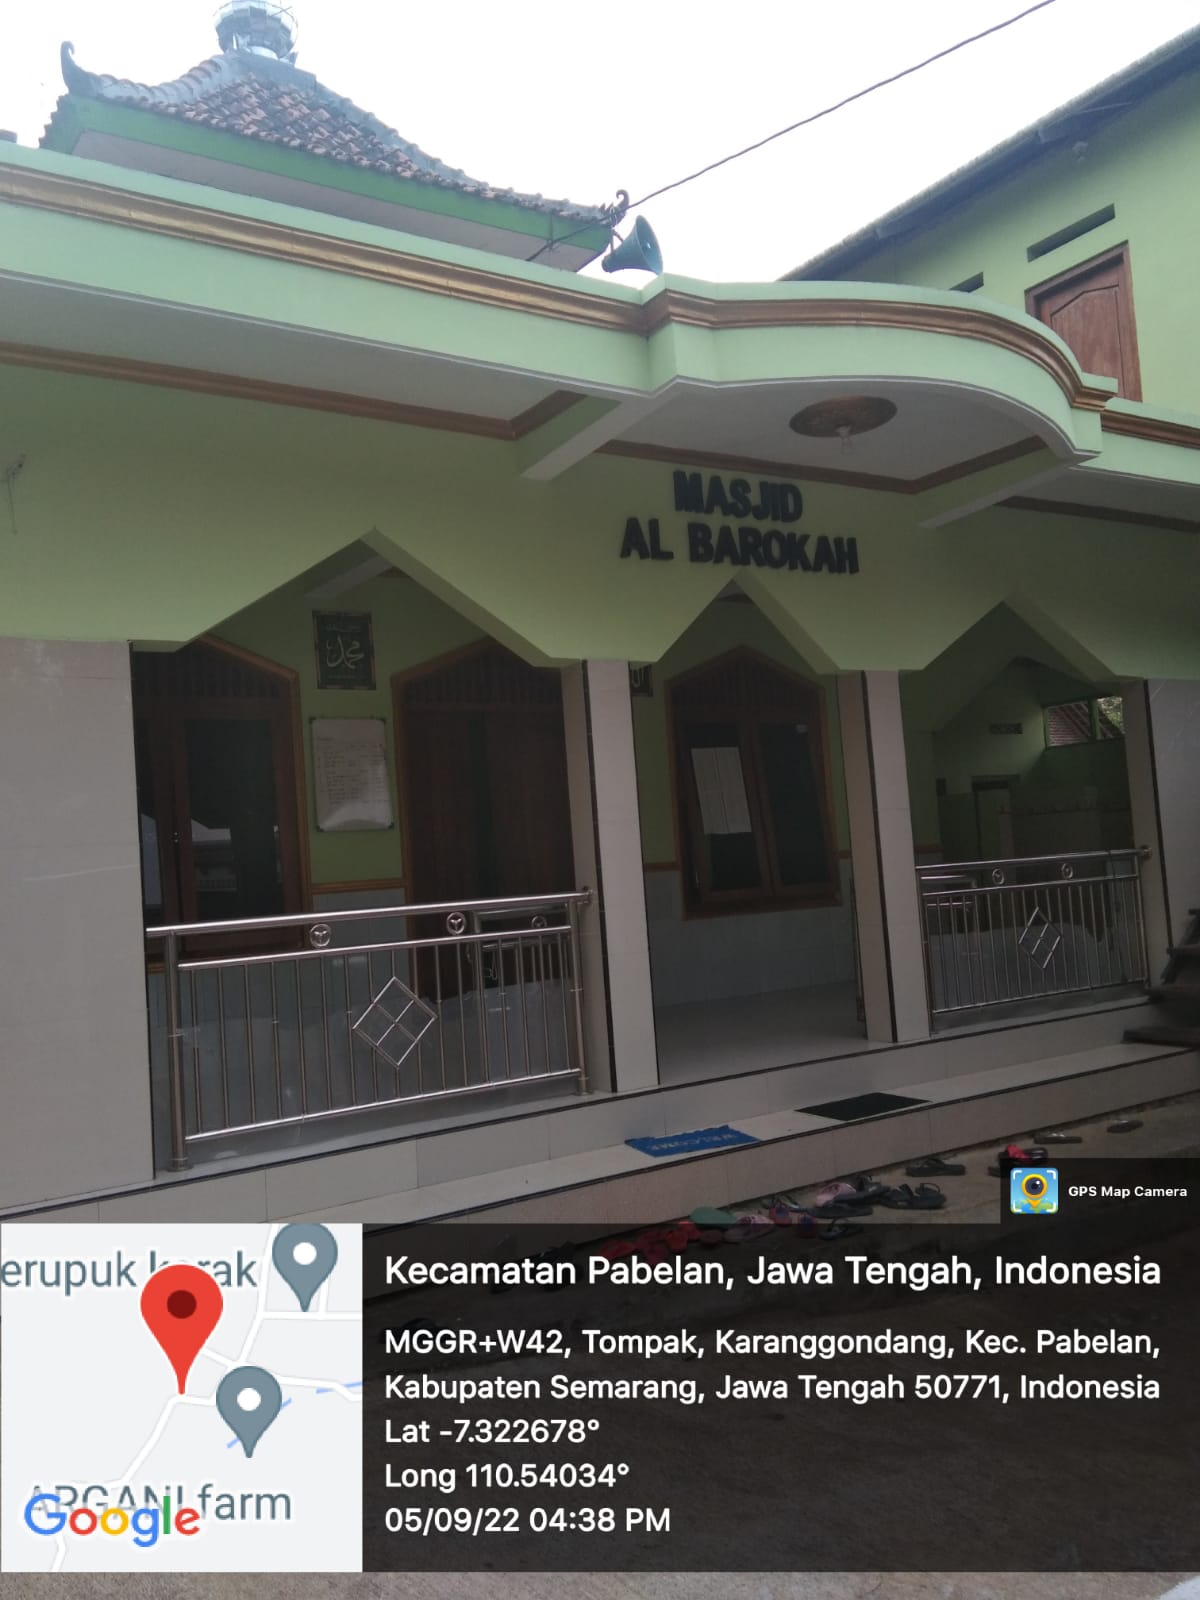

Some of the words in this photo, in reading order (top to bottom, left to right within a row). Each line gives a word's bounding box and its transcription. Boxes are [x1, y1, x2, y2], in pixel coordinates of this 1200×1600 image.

[673, 470, 803, 522] MASJID
[620, 517, 674, 560] AL
[687, 522, 859, 574] BAROKAH
